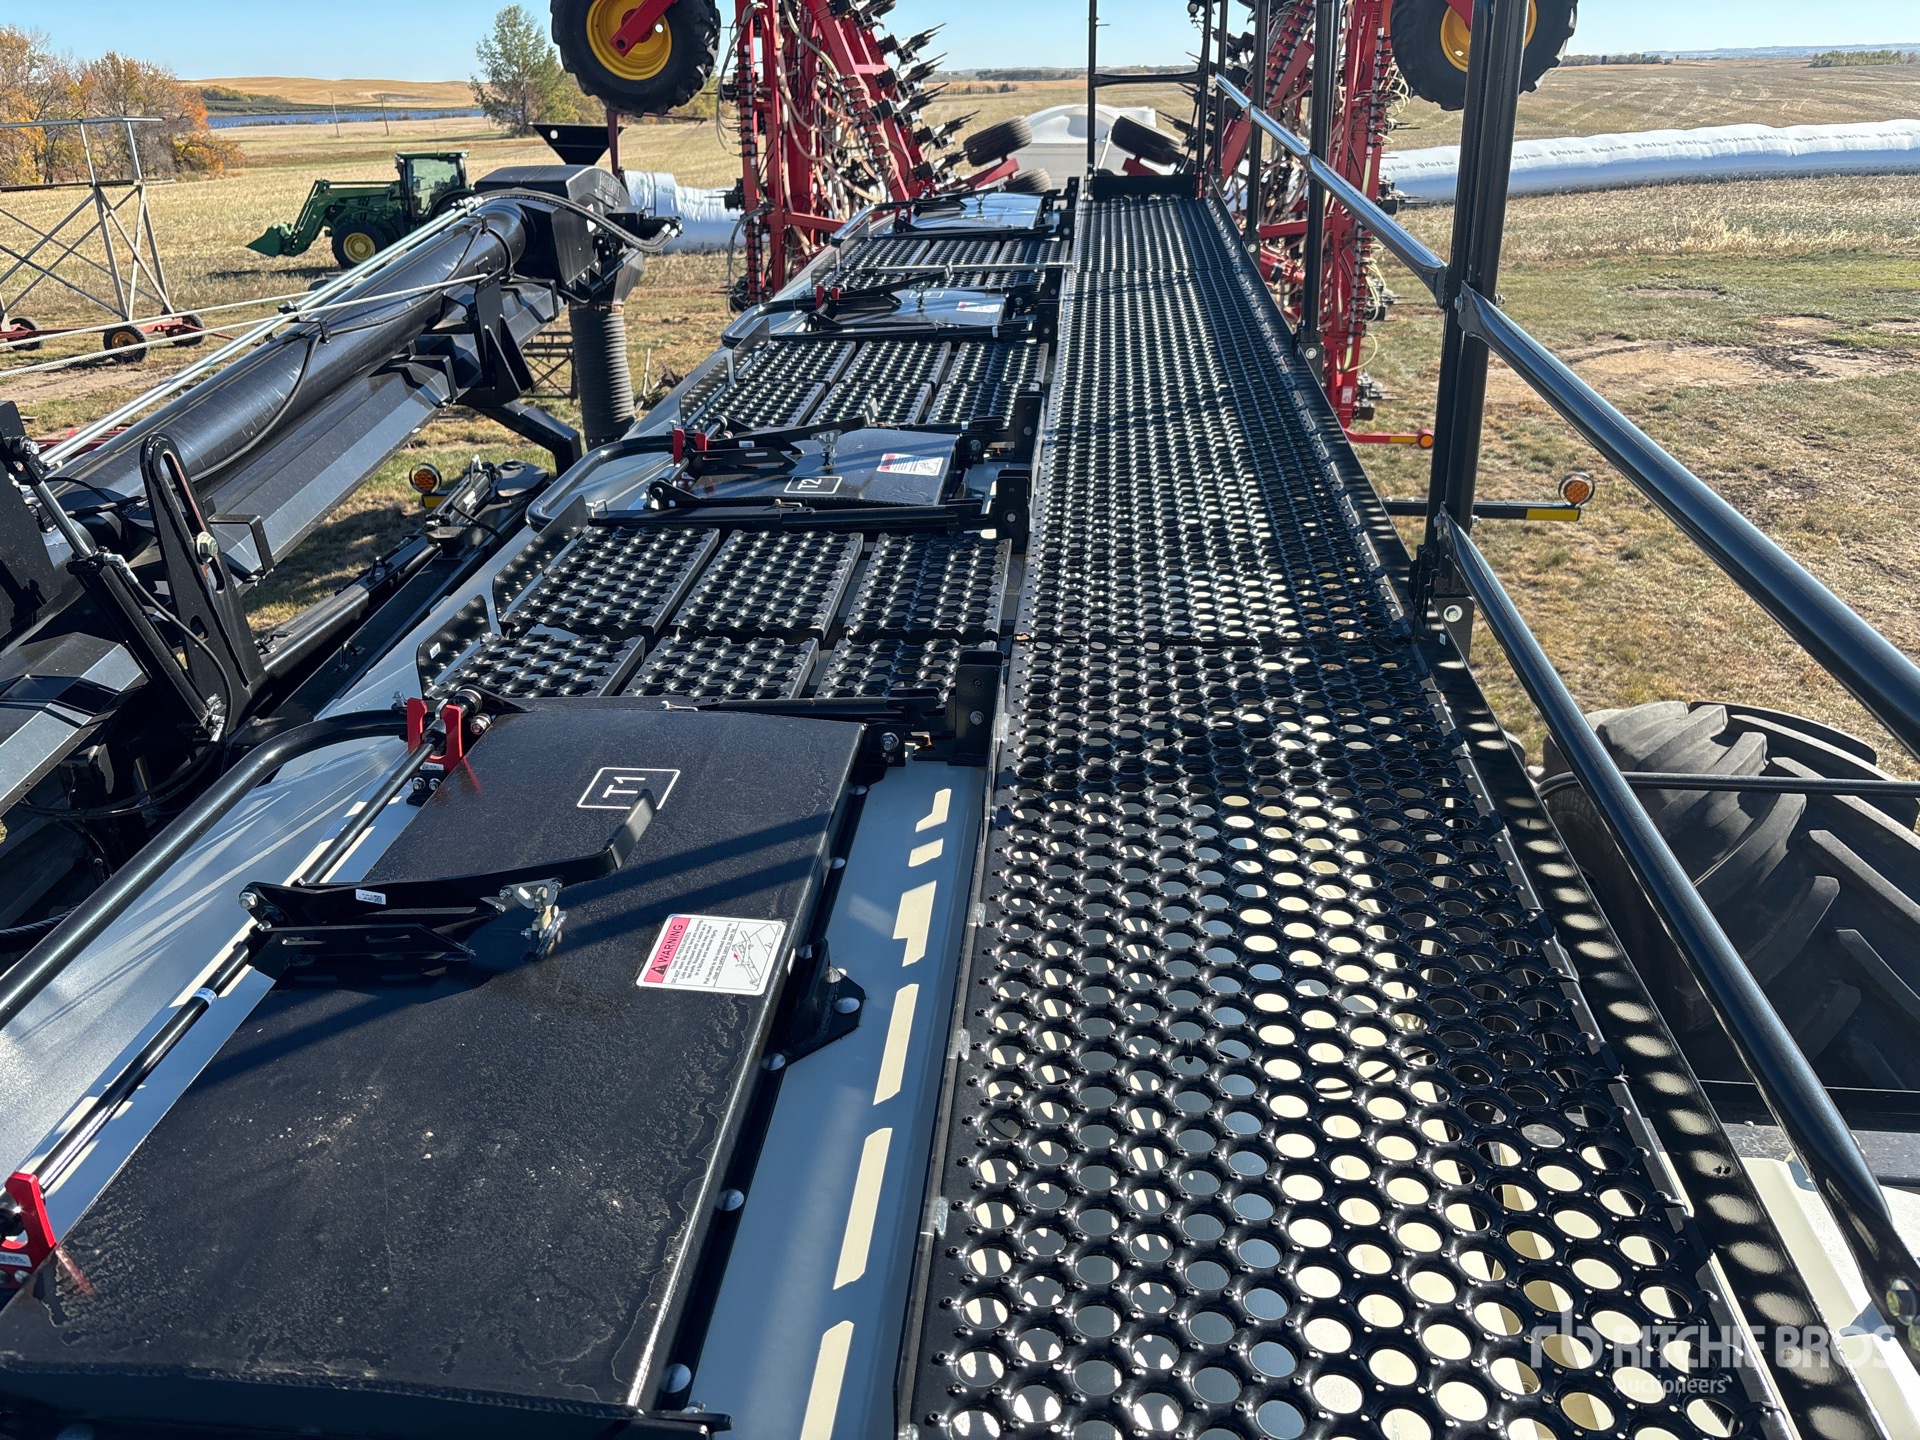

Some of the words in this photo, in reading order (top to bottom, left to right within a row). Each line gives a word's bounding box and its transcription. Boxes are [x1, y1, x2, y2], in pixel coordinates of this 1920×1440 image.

[797, 478, 822, 490] T2
[602, 776, 646, 798] T1
[657, 924, 684, 962] WARNING
